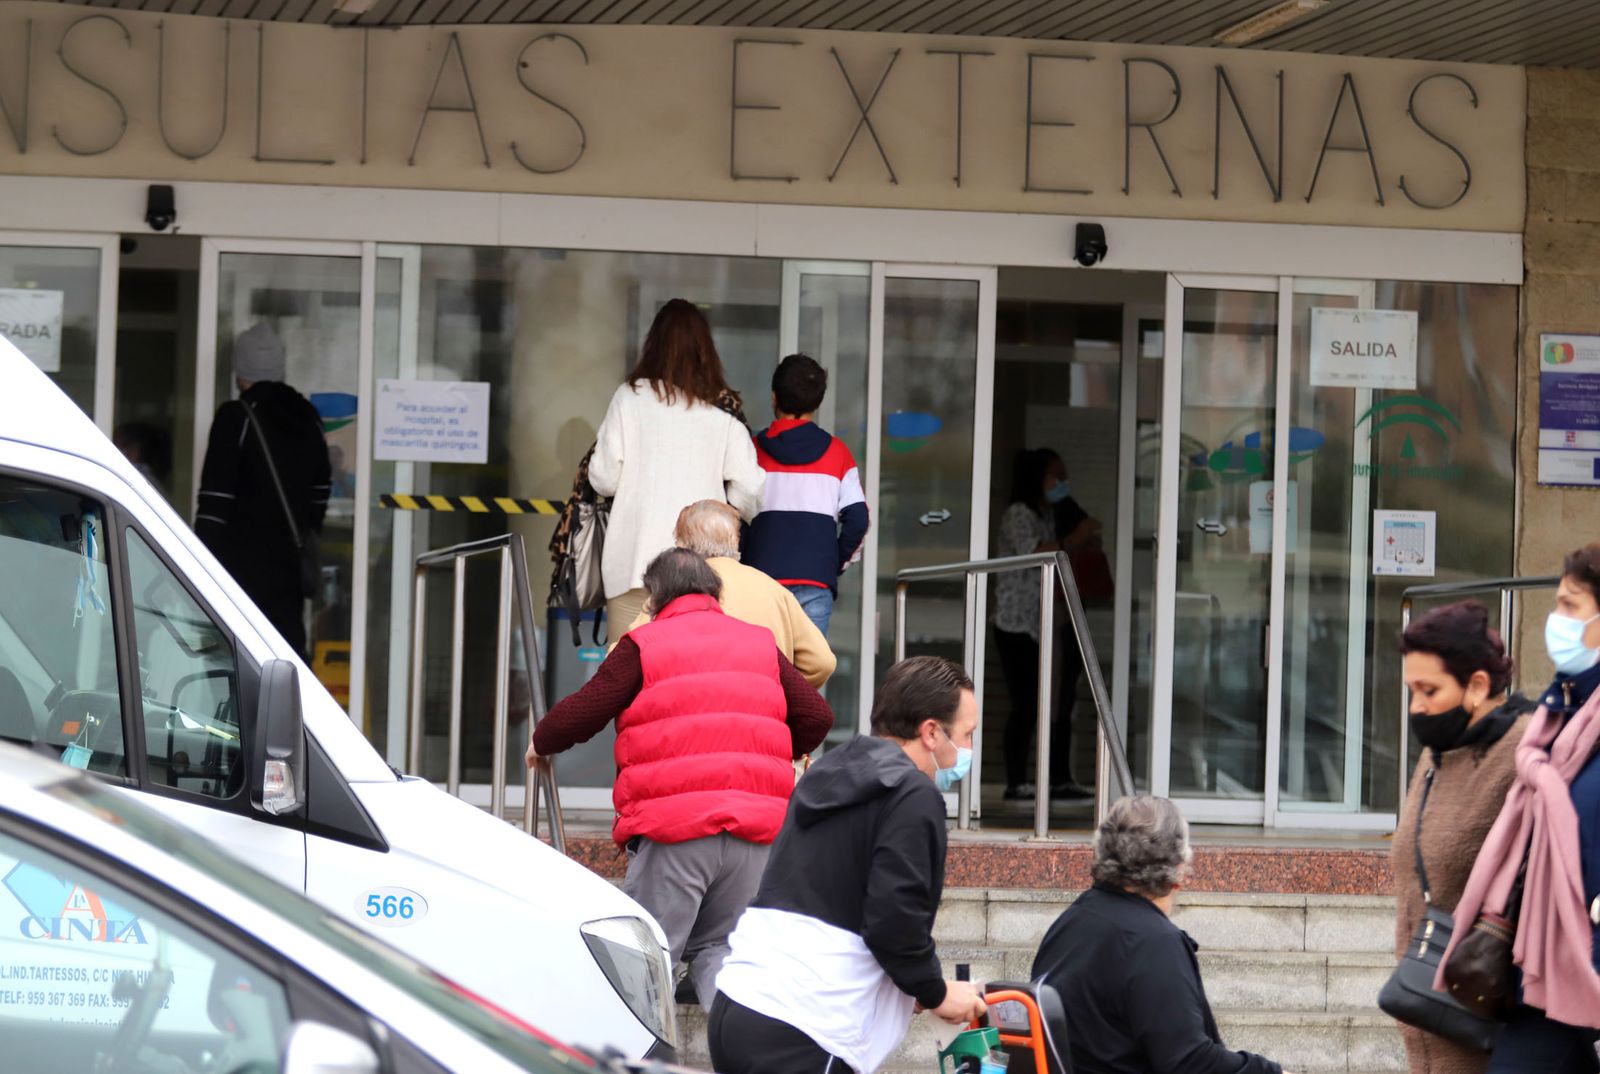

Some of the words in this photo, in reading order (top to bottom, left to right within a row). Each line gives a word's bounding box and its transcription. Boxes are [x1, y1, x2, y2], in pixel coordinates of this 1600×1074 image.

[732, 39, 1478, 210] EXTERNAS
[1330, 340, 1397, 358] SALIDA
[396, 402, 417, 412] Para
[421, 403, 456, 413] acceder
[383, 427, 434, 437] obligatorio
[467, 429, 478, 437] de
[381, 439, 428, 448] mascarilla
[366, 894, 414, 919] 566
[19, 915, 149, 945] CINTA
[0, 965, 90, 984] L.IND.TARTESSOS,
[28, 991, 46, 1006] 959
[48, 992, 65, 1007] 367
[68, 993, 86, 1007] 369
[88, 993, 110, 1008] FAX:
